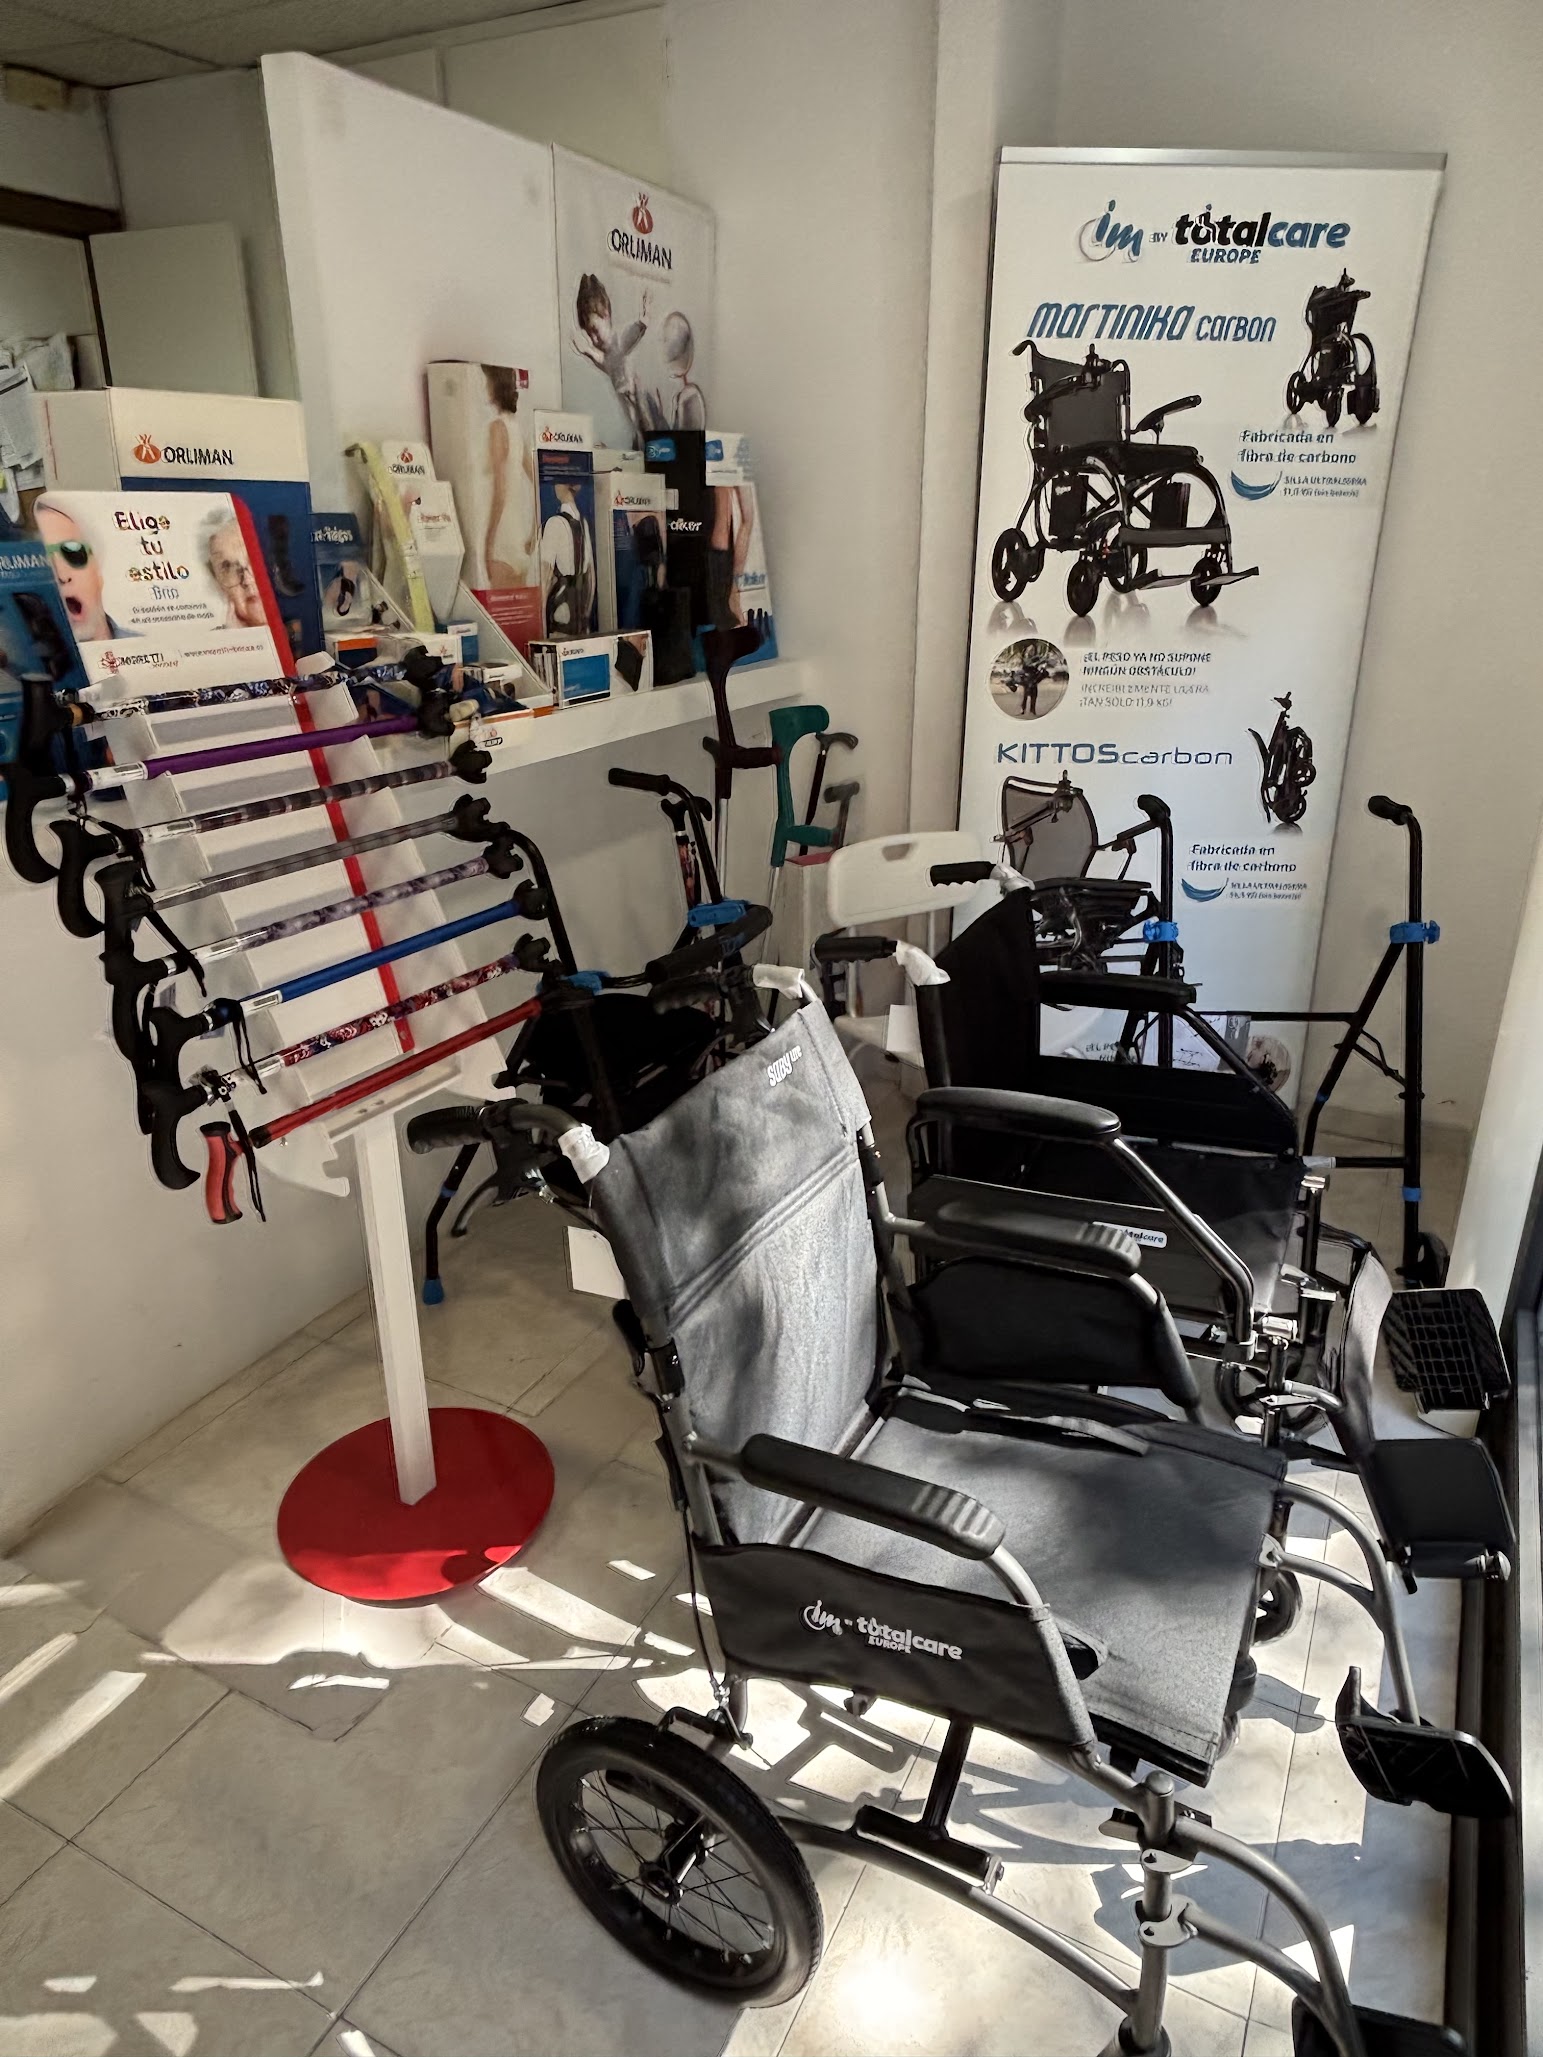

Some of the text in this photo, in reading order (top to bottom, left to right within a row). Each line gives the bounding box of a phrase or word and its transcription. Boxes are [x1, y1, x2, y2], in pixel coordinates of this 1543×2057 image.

[1174, 204, 1351, 249] totalcare
[609, 228, 673, 270] ORLIMAN
[1190, 248, 1262, 264] EUROPE
[1240, 430, 1334, 444] Fabricada en
[163, 446, 235, 465] ORLIMAN
[1238, 449, 1357, 464] fibra de carbono
[114, 511, 171, 535] Elige
[140, 536, 163, 556] tu
[127, 561, 190, 582] estilo
[1133, 652, 1147, 663] YA
[1189, 844, 1275, 856] Fabricada en
[1187, 859, 1297, 873] fibra de carbono
[857, 1616, 964, 1661] totalcare
[868, 1635, 912, 1654] EUROPE
